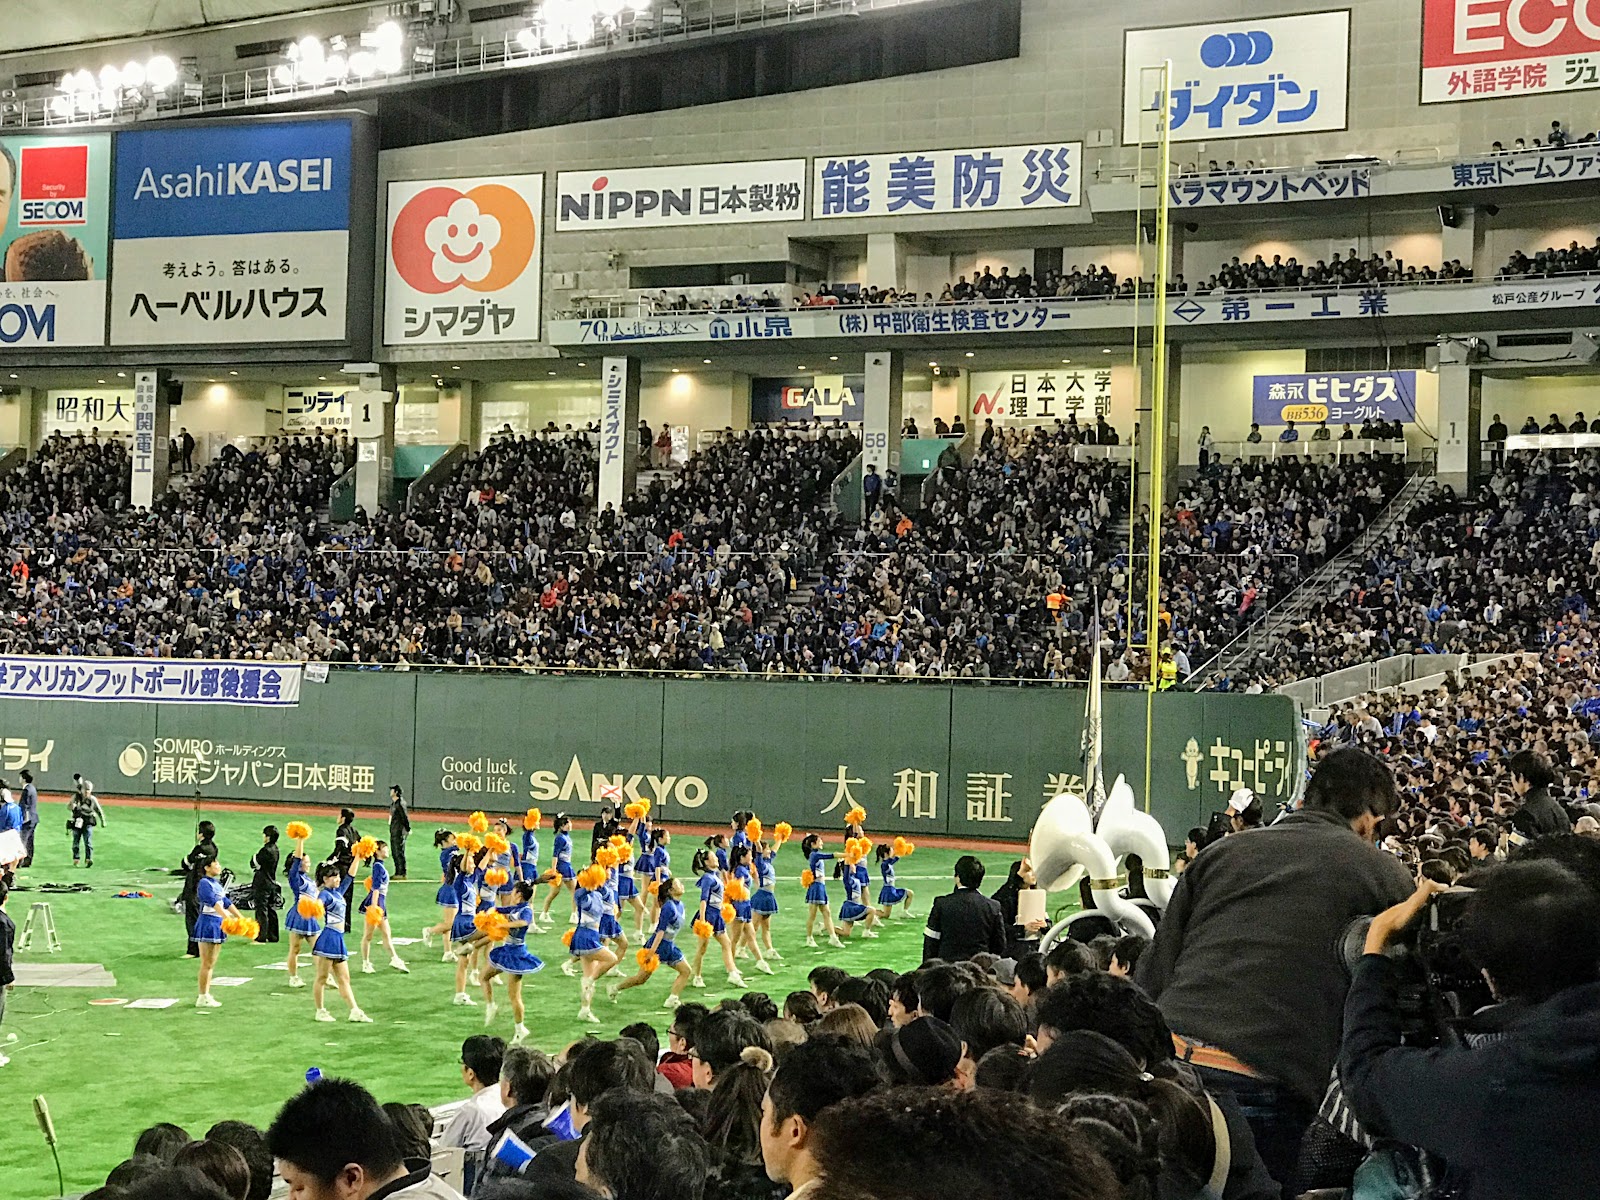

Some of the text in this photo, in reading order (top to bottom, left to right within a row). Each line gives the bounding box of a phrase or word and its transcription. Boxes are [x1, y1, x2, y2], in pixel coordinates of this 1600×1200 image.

[1447, 62, 1547, 96] 外語学院
[1151, 73, 1318, 132] ダイダン
[42, 183, 66, 192] Security
[821, 147, 1073, 215] 能美防災
[1169, 168, 1371, 206] パラマウントベッド
[49, 190, 58, 198] by
[698, 182, 801, 215] 日本製粉
[23, 200, 83, 220] SECOM
[130, 286, 327, 322] ヘーベルハウス
[1222, 289, 1389, 321] 第一工業
[1492, 289, 1586, 305] 松戸公産グループ
[404, 299, 516, 338] シマダヤ
[735, 316, 793, 339] 小泉
[1010, 371, 1112, 395] 日本大学
[1268, 376, 1398, 404] 森永 ビヒダス
[56, 396, 135, 423] 昭和大
[786, 387, 856, 408] GALA
[1009, 395, 1112, 418] 理工学部
[362, 403, 372, 423] 1
[604, 374, 622, 465] シミズオクト
[1286, 405, 1325, 421] BB536
[1331, 406, 1386, 420] ヨーグルト
[134, 412, 153, 473] 関電工
[865, 432, 886, 448] 58
[153, 737, 213, 755] SOMPO
[152, 758, 375, 793] 損保ジャパン日本興亜
[441, 756, 523, 776] Good luck.
[441, 774, 515, 794] Good life.
[529, 754, 709, 808] SANKYO
